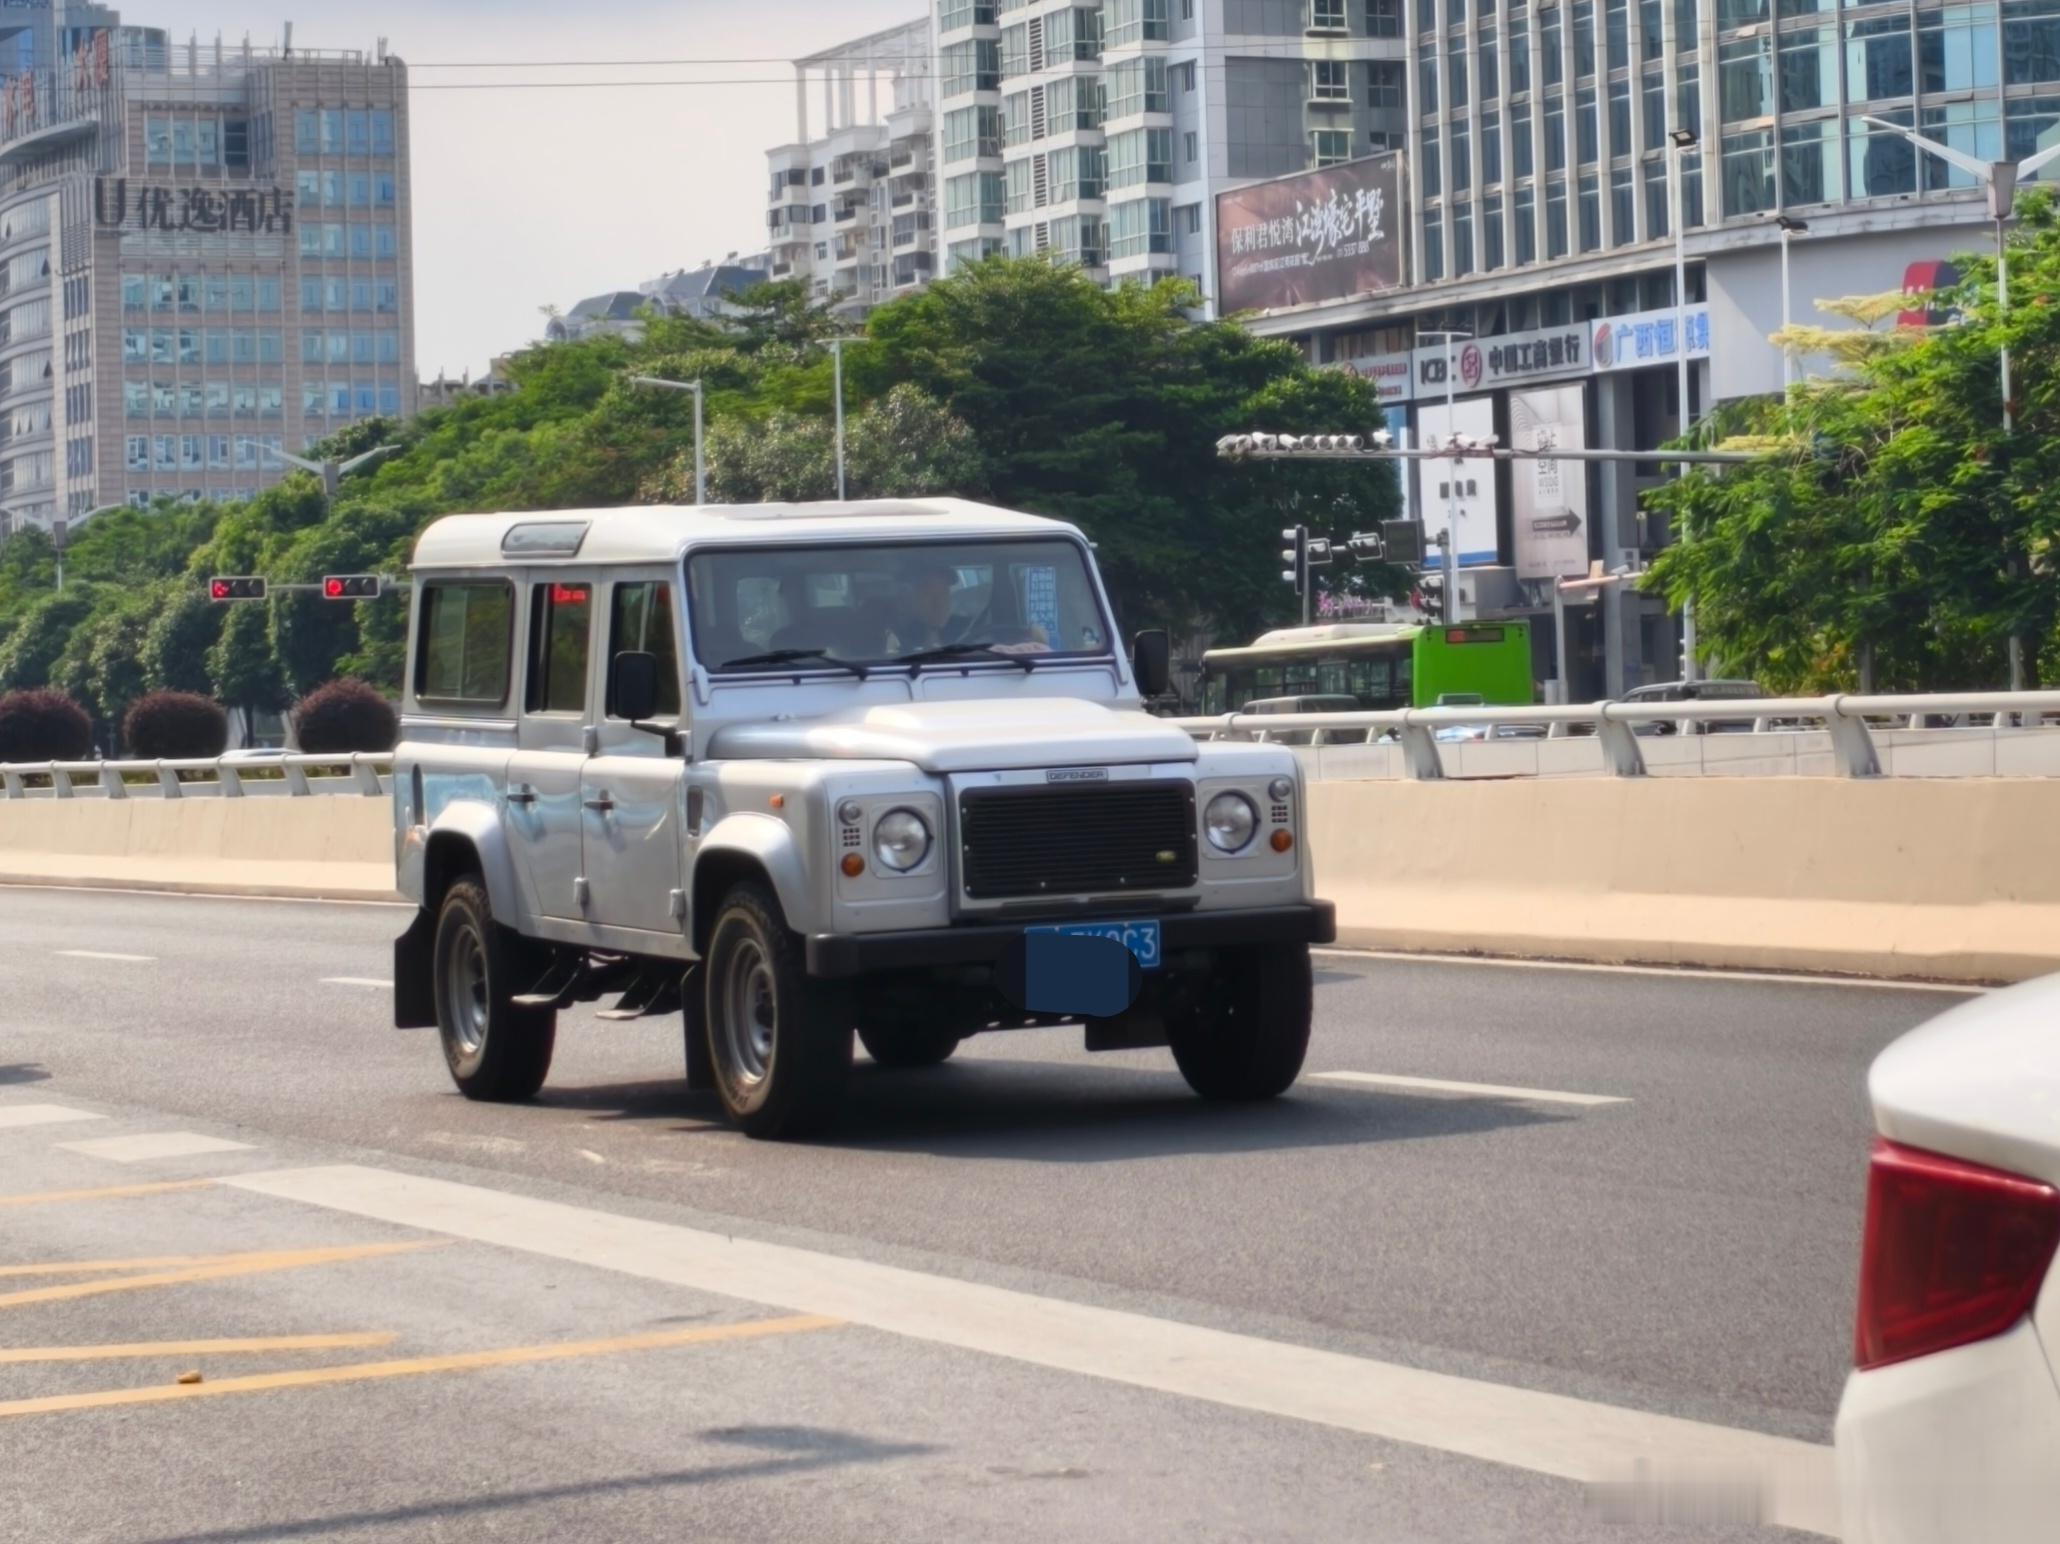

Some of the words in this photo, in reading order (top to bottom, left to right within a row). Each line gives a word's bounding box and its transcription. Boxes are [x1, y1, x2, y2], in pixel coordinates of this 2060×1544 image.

[95, 177, 126, 226] U
[137, 186, 295, 234] 优逸酒店
[1488, 333, 1580, 376] 中国工商银行
[1048, 768, 1105, 781] DEFENDER
